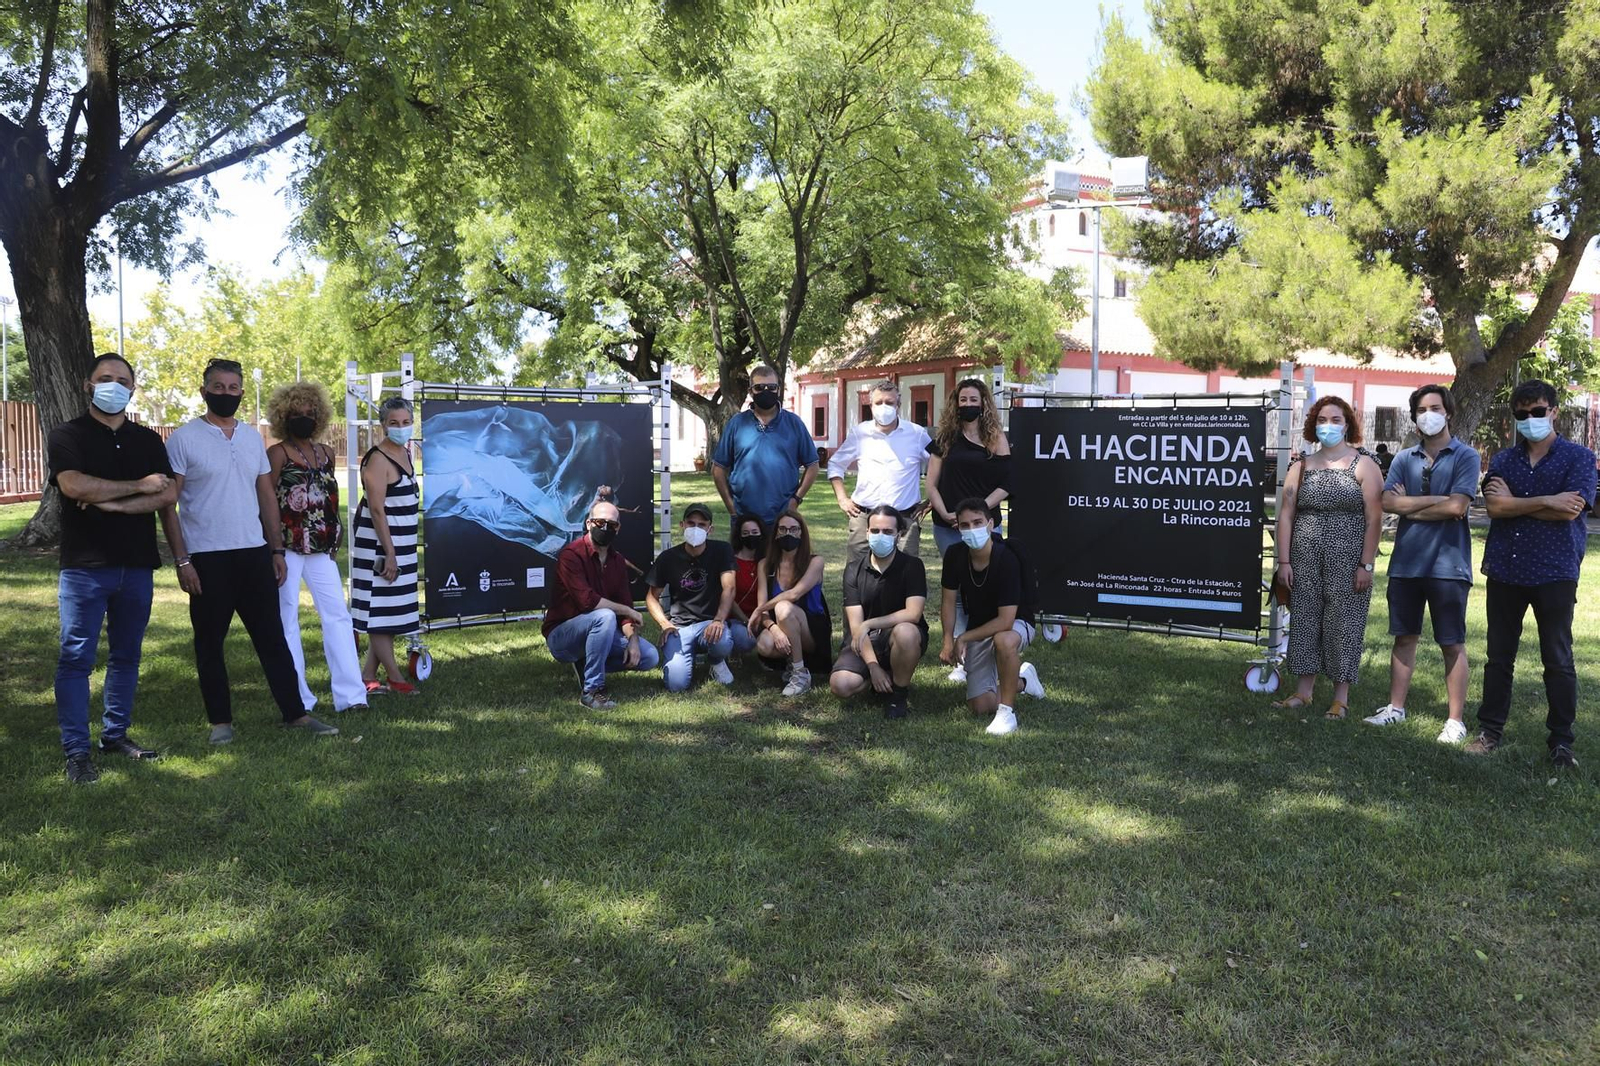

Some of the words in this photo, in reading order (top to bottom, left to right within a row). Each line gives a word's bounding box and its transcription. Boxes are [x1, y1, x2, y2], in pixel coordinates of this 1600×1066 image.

[1150, 414, 1168, 422] partir
[1194, 414, 1209, 422] julio
[1034, 433, 1071, 459] LA
[1080, 433, 1254, 462] HACIENDA
[1114, 465, 1253, 487] ENCANTADA
[1068, 495, 1092, 507] DEL
[1095, 496, 1109, 507] 19
[1112, 496, 1129, 508] AL
[1132, 497, 1148, 509] 30
[1152, 498, 1169, 510] DE
[1173, 498, 1215, 511] JULIO
[1218, 499, 1252, 512] 2021
[1163, 513, 1177, 524] La
[1180, 513, 1250, 527] Rinconada
[1097, 573, 1128, 581] Hacienda
[1129, 574, 1147, 582] Santa
[1148, 575, 1165, 583] Cruz
[1170, 576, 1185, 584] Ctra
[1186, 577, 1196, 585] de
[1114, 582, 1149, 591] Rinconada
[1163, 585, 1182, 593] horas
[1188, 587, 1214, 596] Entrada
